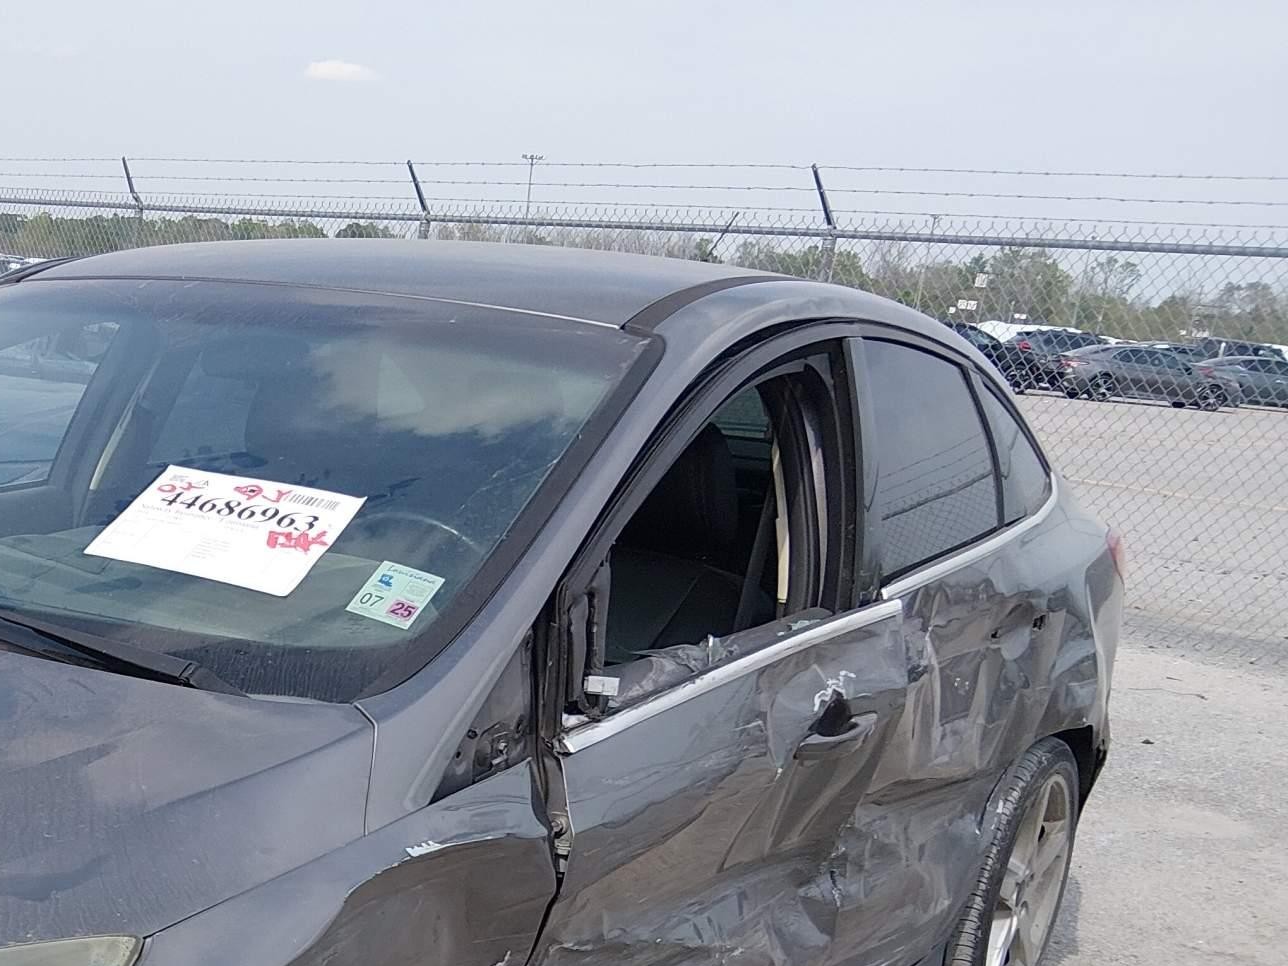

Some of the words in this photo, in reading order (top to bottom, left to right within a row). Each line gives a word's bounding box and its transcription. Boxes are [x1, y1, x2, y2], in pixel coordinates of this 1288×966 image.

[160, 490, 320, 533] 44686963
[359, 592, 385, 607] 07
[390, 602, 417, 618] 25
